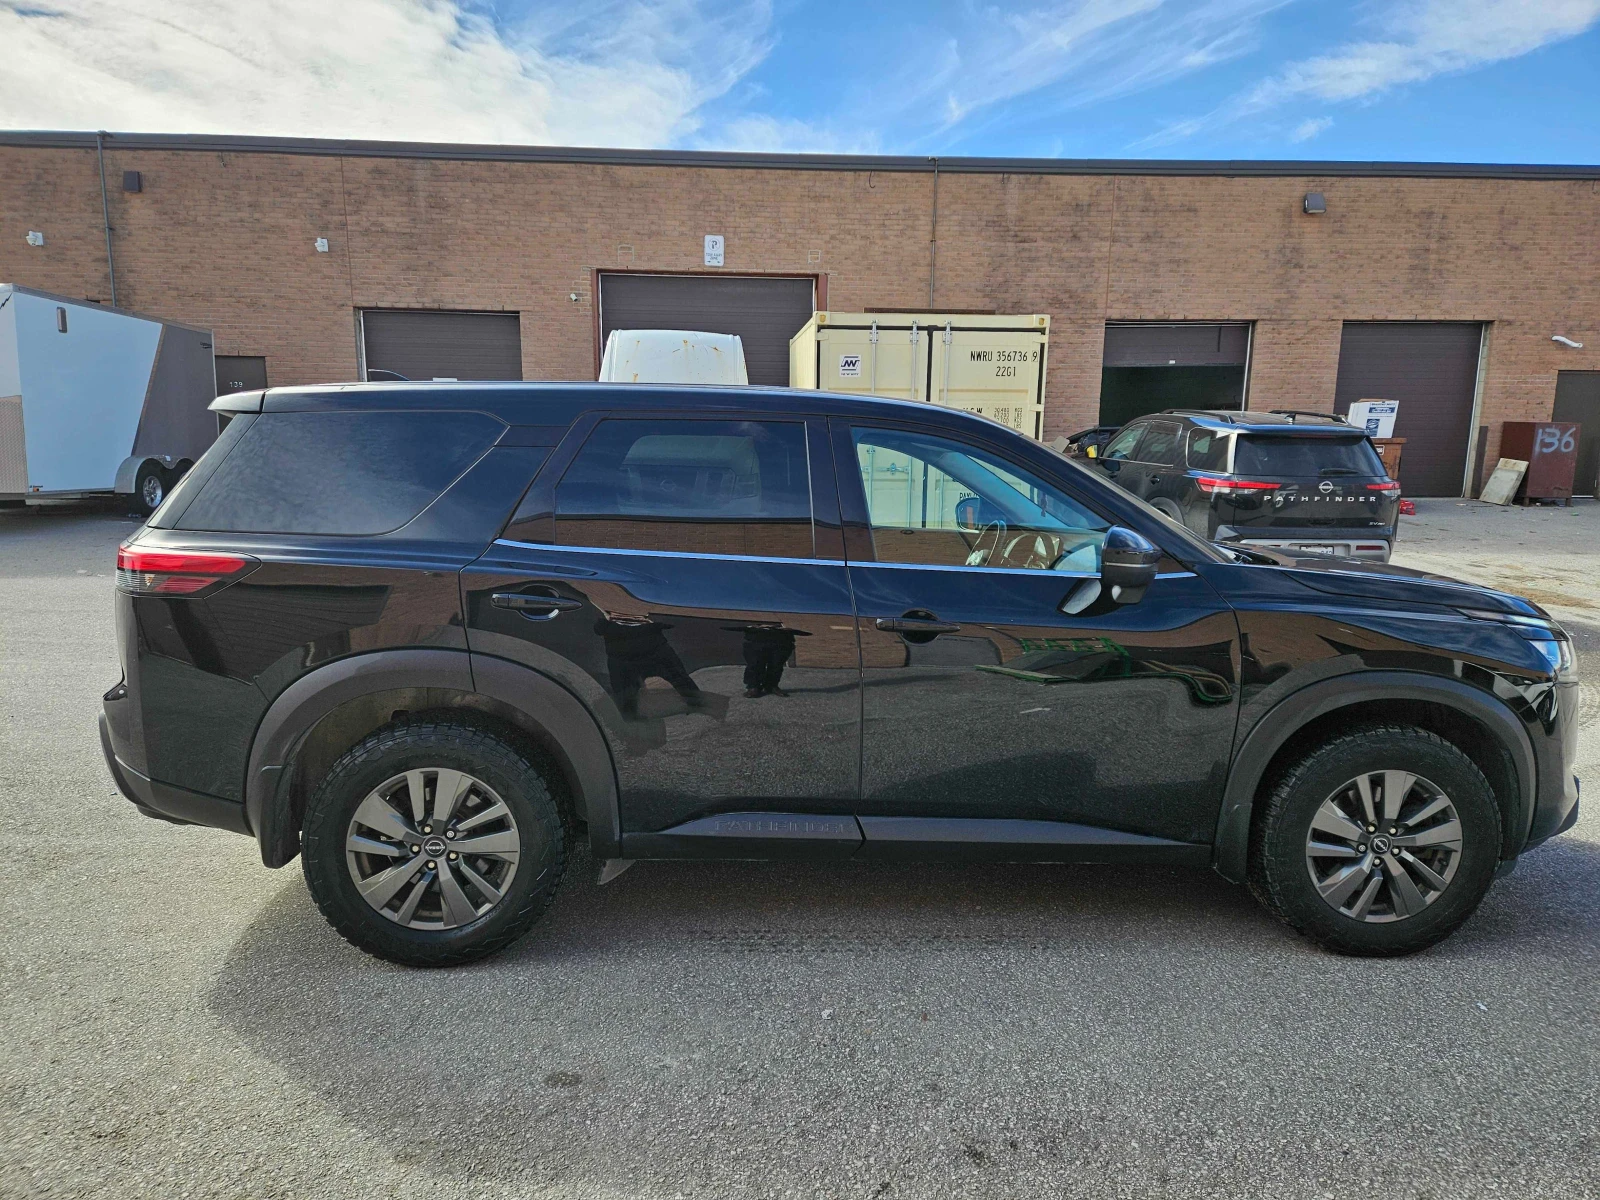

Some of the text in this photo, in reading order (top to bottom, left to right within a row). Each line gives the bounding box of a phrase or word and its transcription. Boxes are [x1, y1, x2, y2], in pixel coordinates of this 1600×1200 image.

[970, 350, 1038, 362] NWRU 356736 9
[995, 366, 1016, 377] 22G1
[1534, 426, 1576, 456] 136
